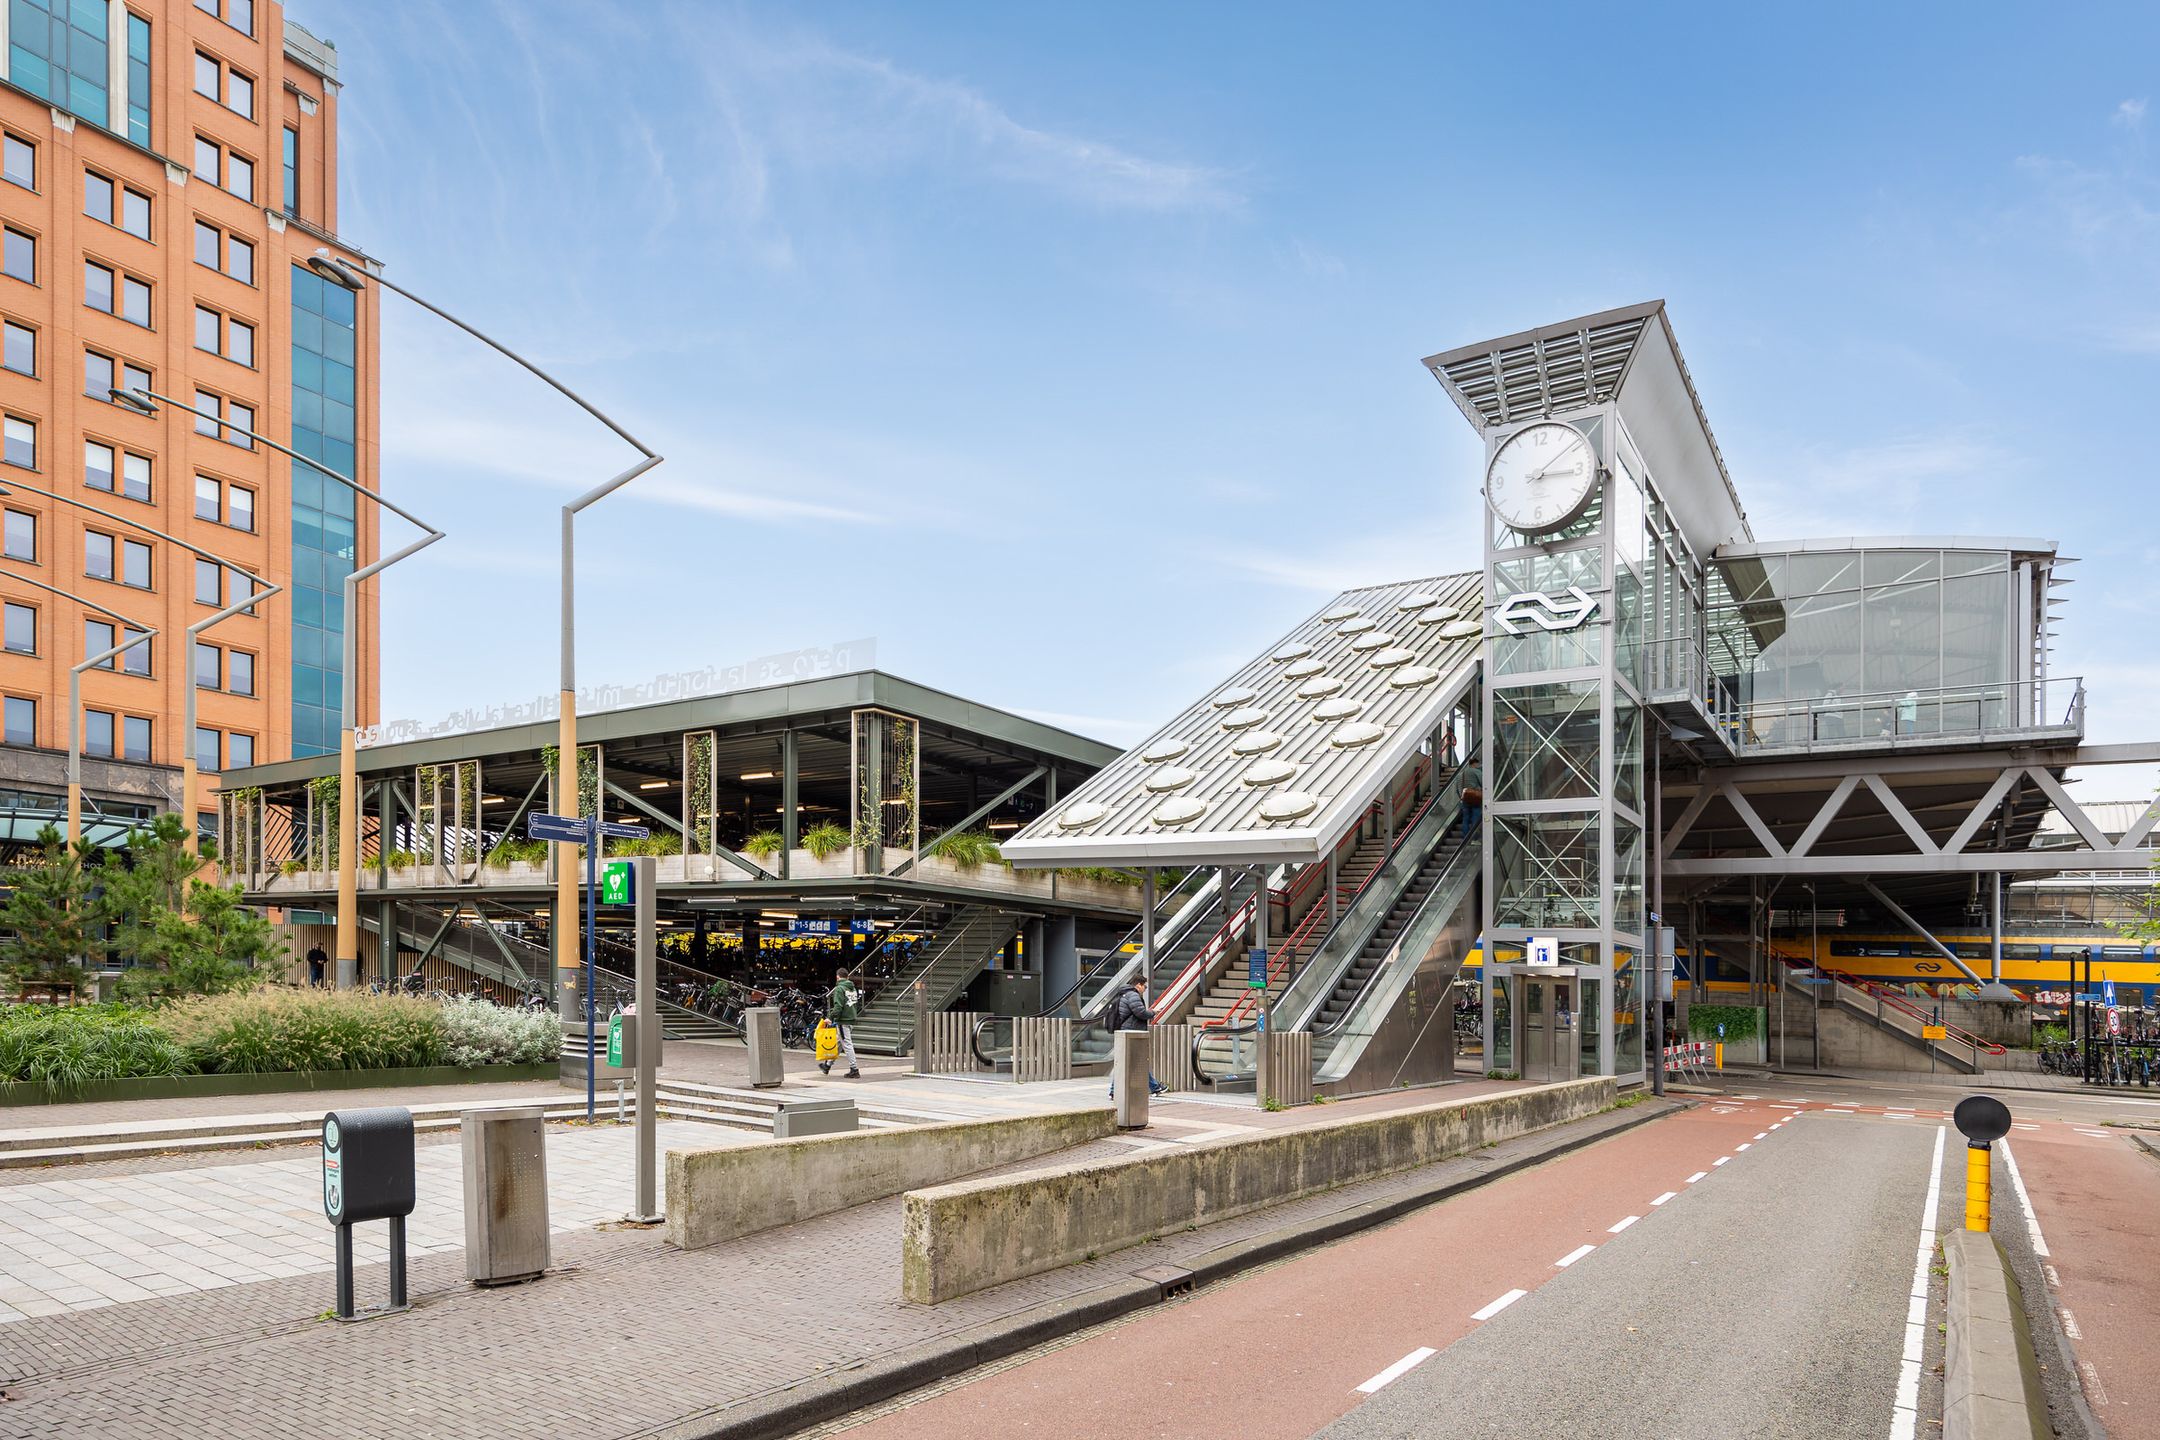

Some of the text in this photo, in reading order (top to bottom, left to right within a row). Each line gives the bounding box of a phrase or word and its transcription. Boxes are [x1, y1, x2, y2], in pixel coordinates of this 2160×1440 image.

[1532, 431, 1548, 446] 12
[1574, 461, 1584, 476] 3
[1495, 475, 1504, 490] 9
[1534, 505, 1542, 519] 6
[608, 892, 623, 900] AED
[799, 921, 809, 929] 1-5
[856, 921, 867, 929] 6-8
[1858, 947, 1865, 957] 2
